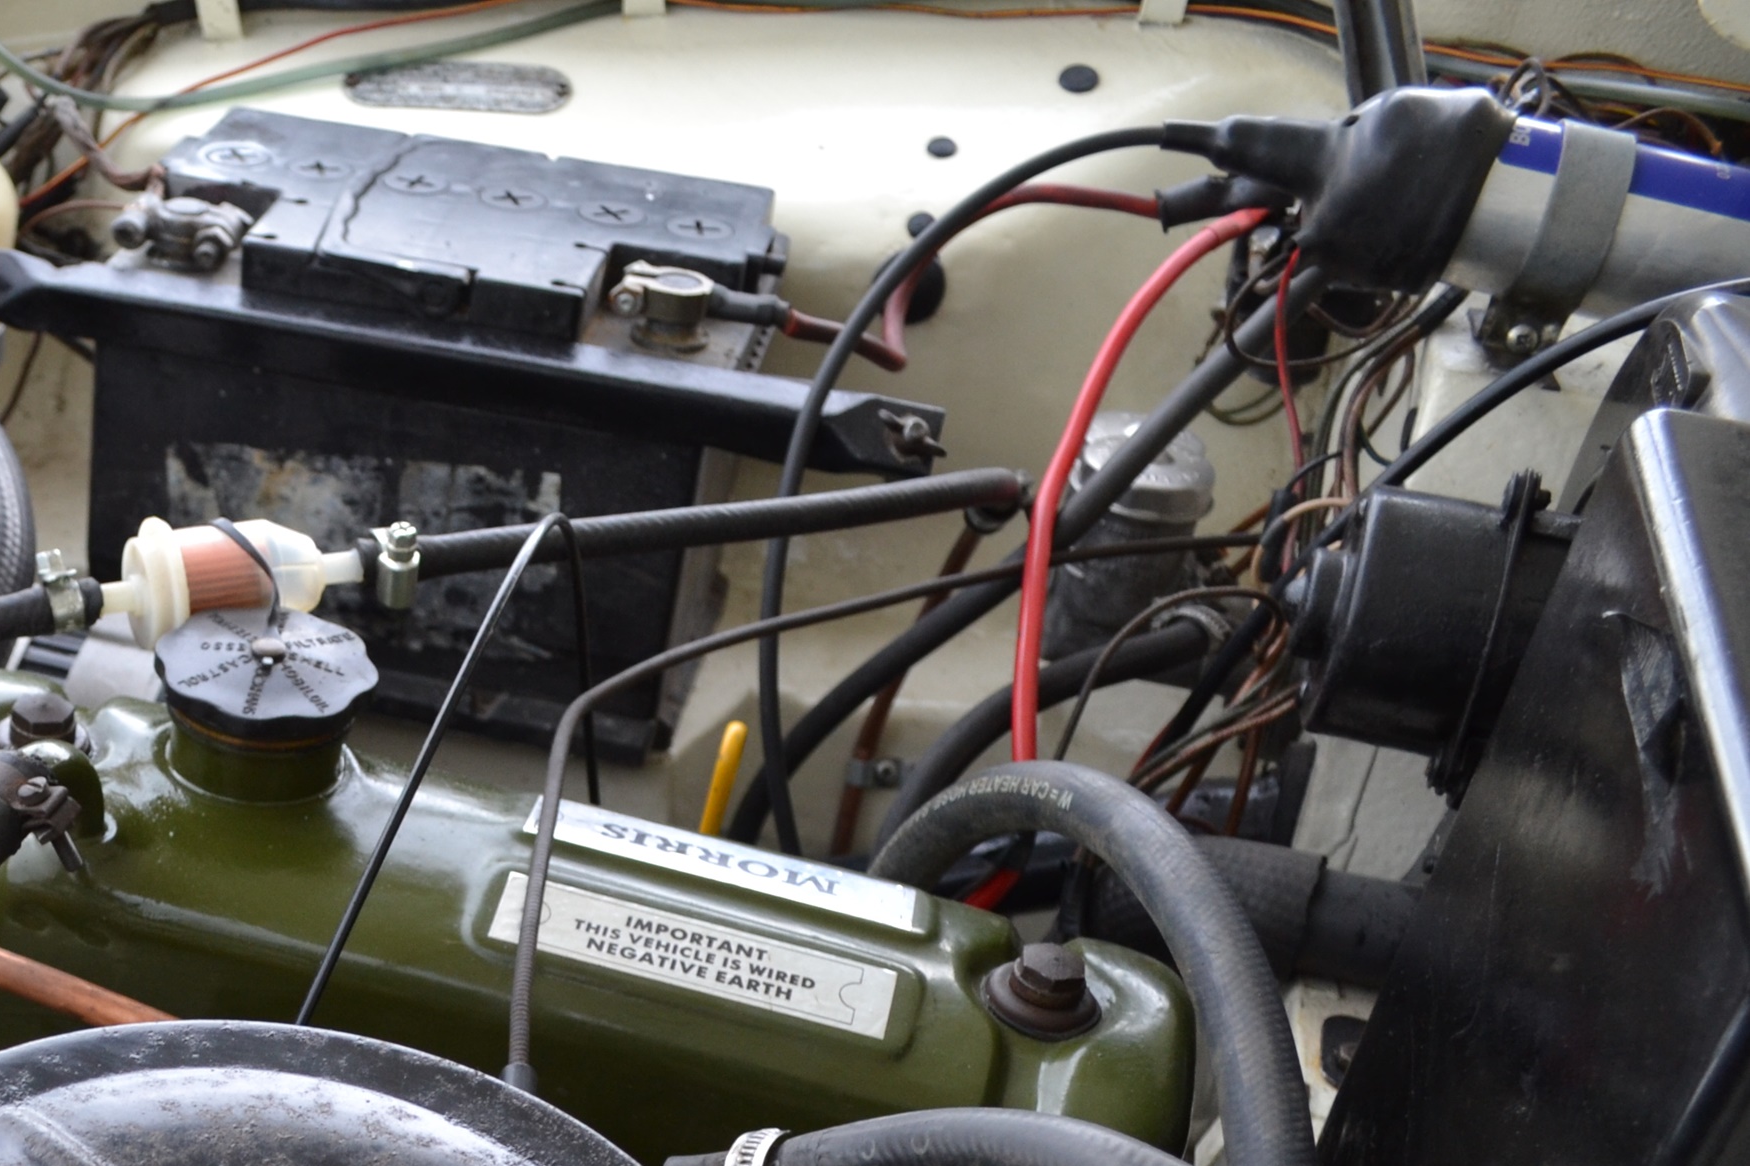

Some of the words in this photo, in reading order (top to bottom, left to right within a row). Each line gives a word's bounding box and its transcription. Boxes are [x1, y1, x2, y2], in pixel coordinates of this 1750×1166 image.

[177, 654, 252, 689] CASTROL
[968, 774, 1021, 795] HEATER
[600, 821, 842, 897] MORRIS
[574, 918, 621, 940] THIS
[629, 932, 717, 966] VEHICLE
[722, 957, 743, 973] IS
[748, 962, 817, 990] WIRED
[625, 915, 769, 963] IMPORTANT
[586, 936, 708, 981] NEGATIVE
[715, 970, 795, 1001] EARTH
